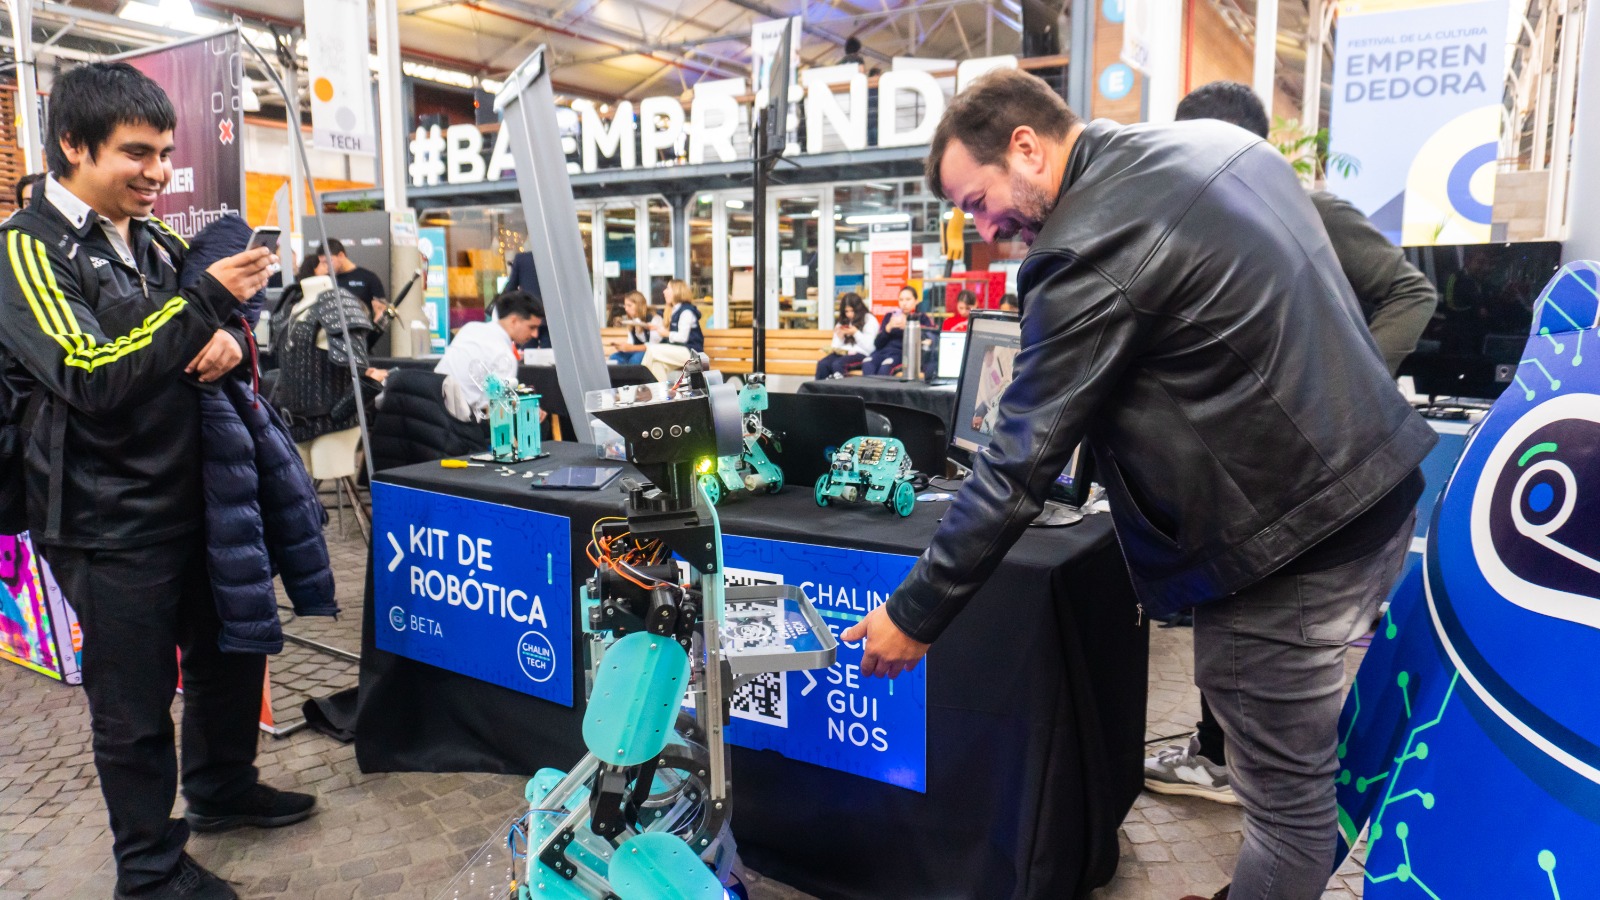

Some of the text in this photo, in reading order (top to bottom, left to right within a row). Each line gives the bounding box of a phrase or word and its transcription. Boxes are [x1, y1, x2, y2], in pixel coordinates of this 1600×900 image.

[1347, 26, 1488, 48] FESTIVAL DE LA CULTURA
[1345, 42, 1488, 77] EMPREN
[1108, 70, 1125, 92] E
[1344, 70, 1488, 103] DEDORA
[329, 133, 361, 151] TECH
[409, 523, 493, 572] KIT DE
[410, 565, 548, 628] ROBÓTICA
[800, 581, 889, 613] CHALIN
[410, 614, 444, 638] BETA
[521, 641, 550, 657] CHALIN
[526, 656, 546, 670] TECH
[826, 661, 860, 689] SE
[826, 689, 878, 722] GUI
[827, 716, 889, 752] NOS
